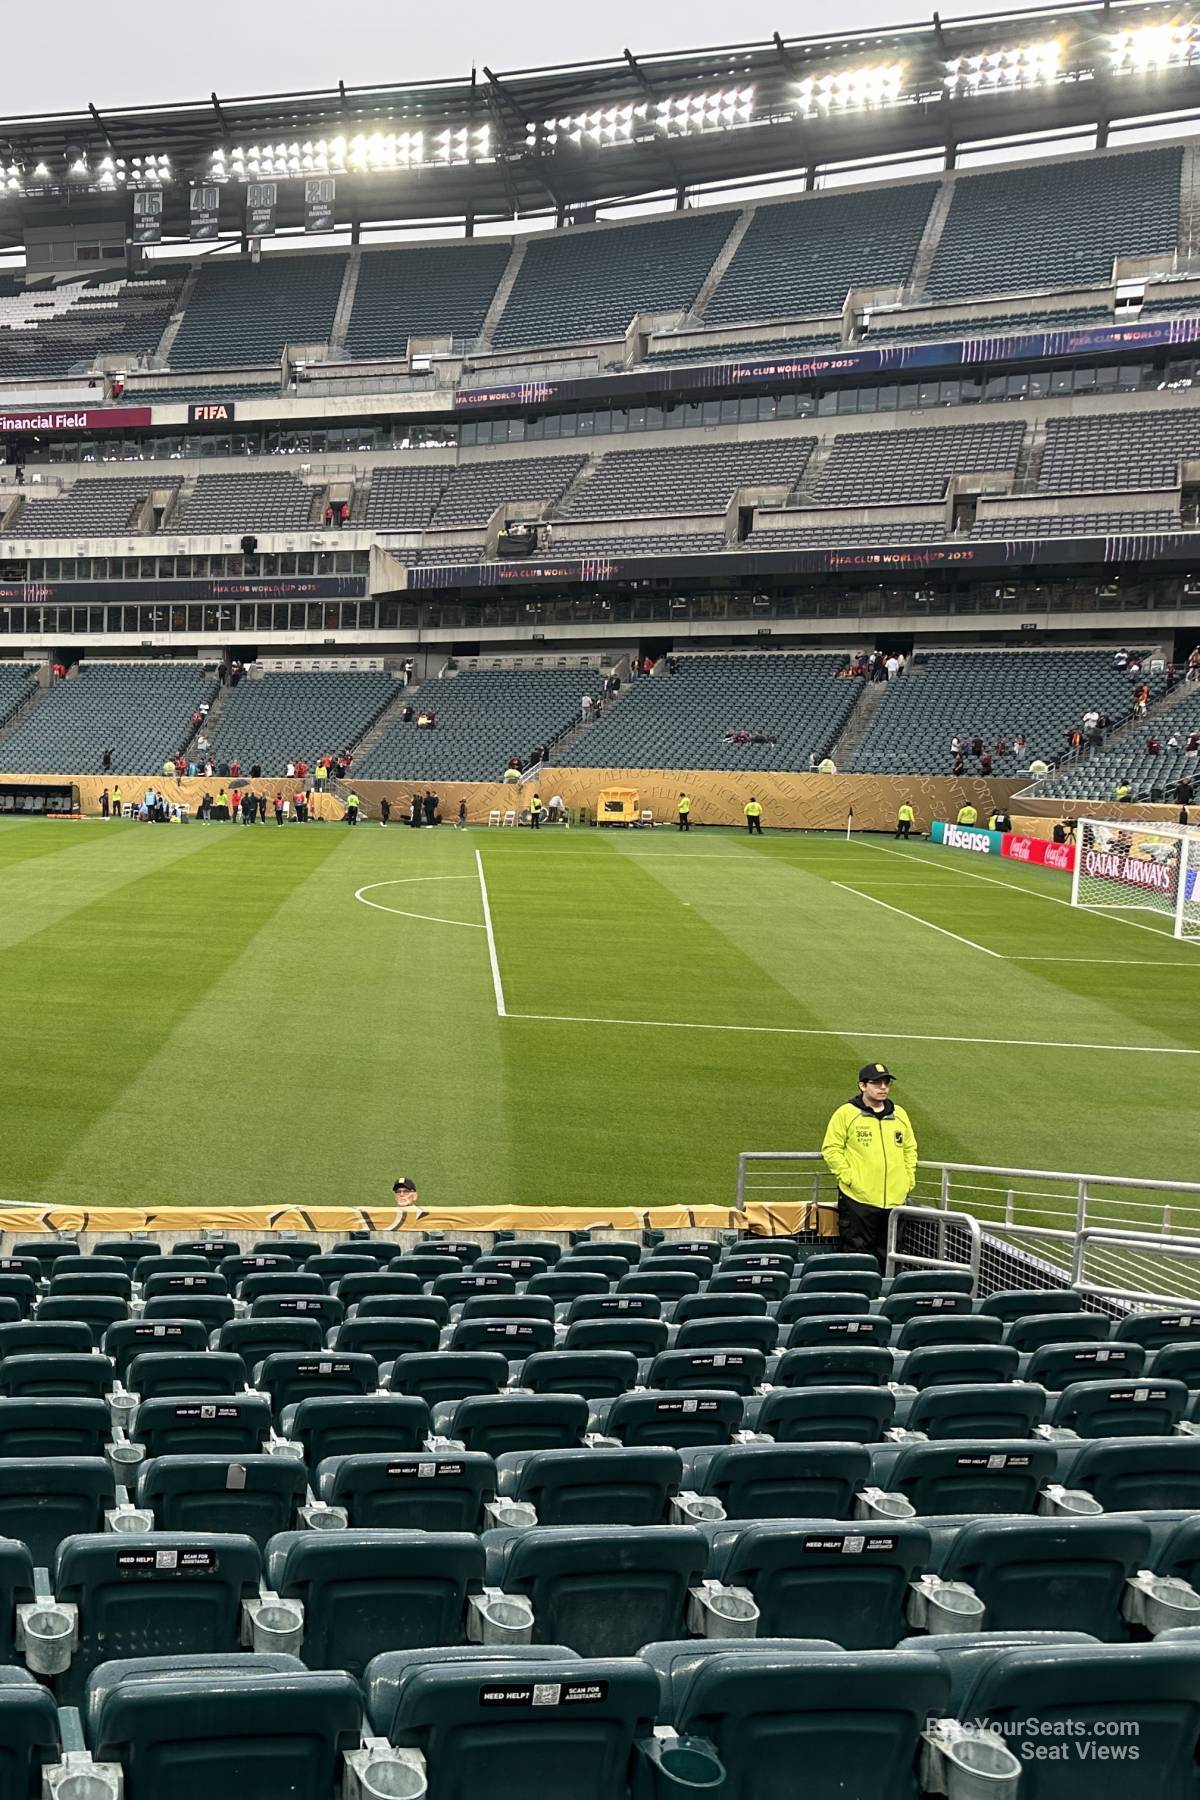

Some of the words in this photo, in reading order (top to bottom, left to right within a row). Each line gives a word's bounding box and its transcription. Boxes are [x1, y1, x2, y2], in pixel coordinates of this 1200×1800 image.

[193, 189, 216, 210] 40
[250, 185, 274, 207] 99
[308, 181, 334, 203] 20
[137, 193, 160, 215] 15
[733, 369, 751, 377] FIFA
[753, 367, 775, 375] CLUB
[777, 364, 809, 373] WORLD
[810, 362, 829, 370] CUP
[469, 395, 487, 403] CLUB
[489, 393, 516, 401] WORLD
[55, 413, 87, 428] Field
[194, 405, 228, 420] FIFA
[942, 823, 990, 853] Hisense
[1085, 851, 1120, 877] QATAR
[1122, 857, 1170, 888] AIRWAYS
[565, 1692, 602, 1700] ASSISTANCE
